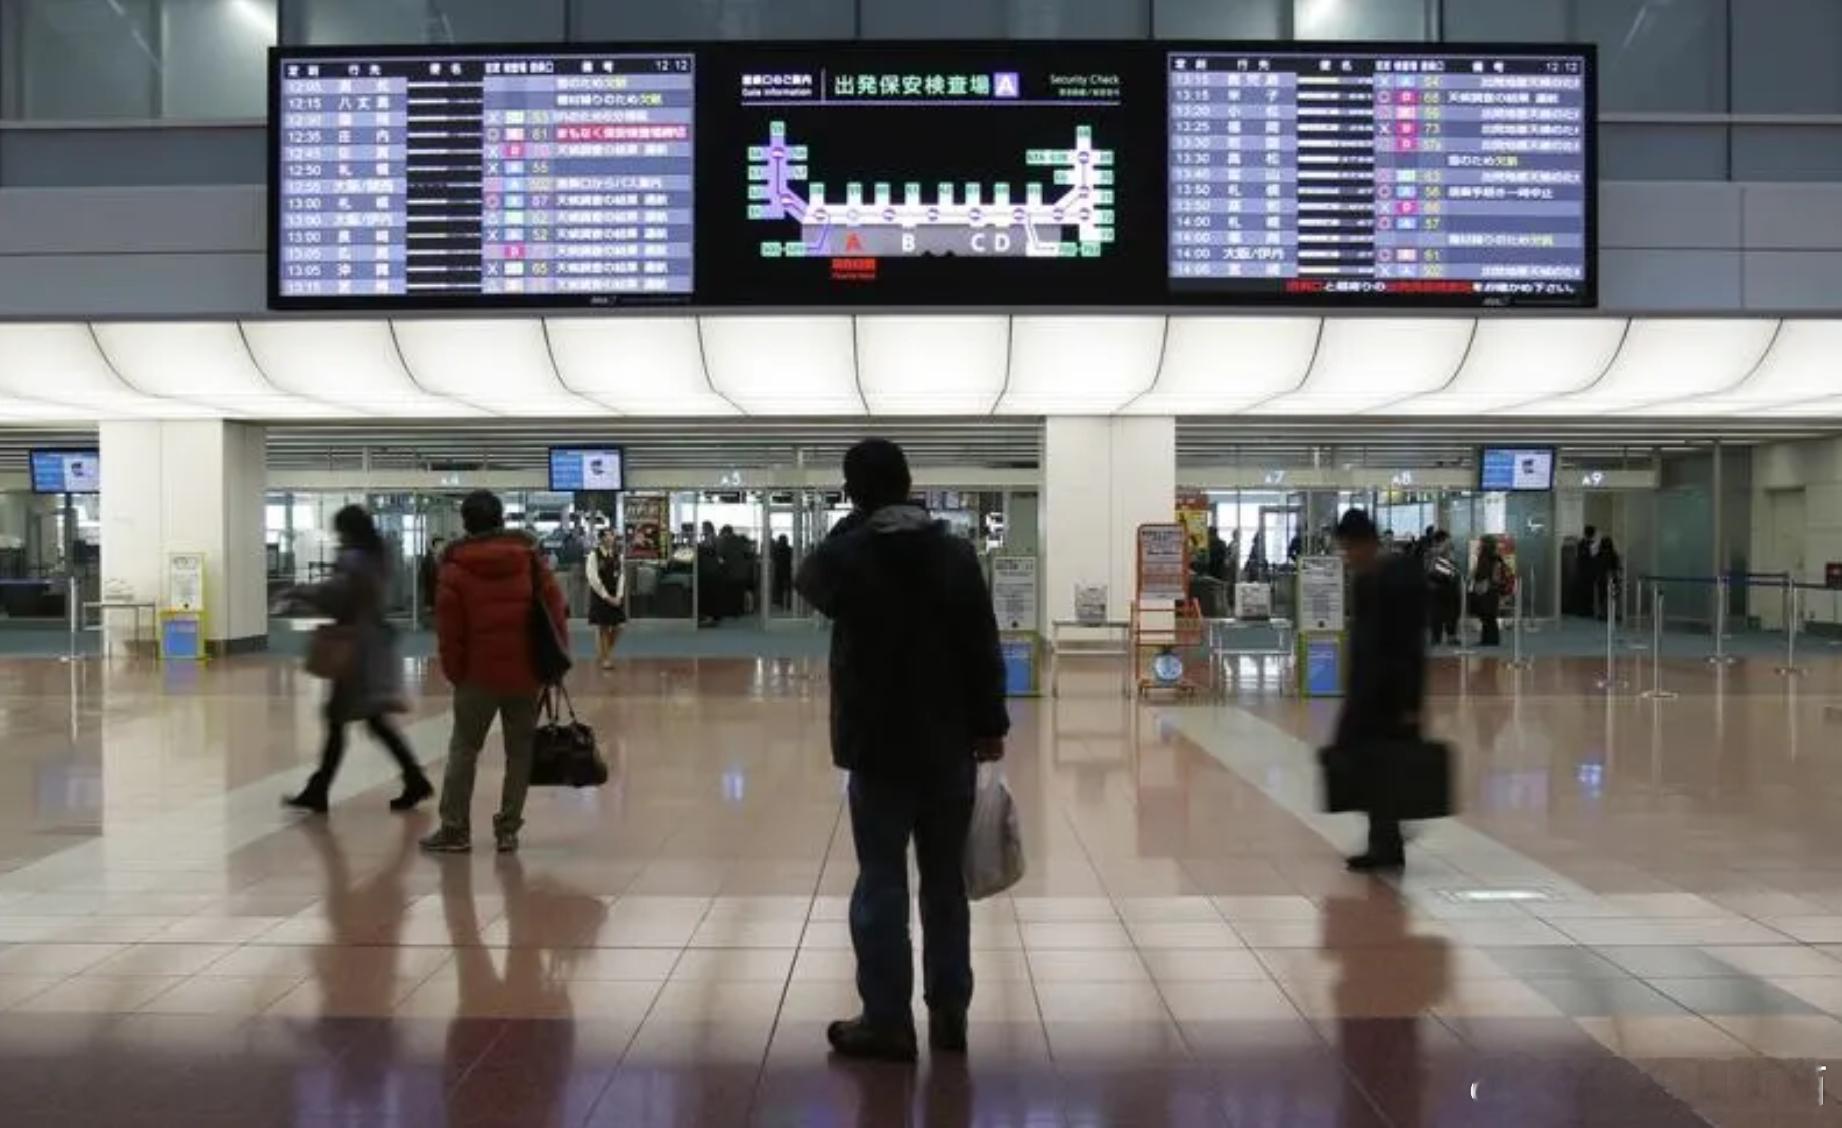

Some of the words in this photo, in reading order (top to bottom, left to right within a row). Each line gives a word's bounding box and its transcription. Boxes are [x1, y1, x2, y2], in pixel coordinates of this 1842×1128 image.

[834, 74, 990, 96] 出発保安検査場
[1051, 74, 1087, 86] Security
[1091, 74, 1120, 85] Check
[846, 232, 862, 252] A
[902, 233, 916, 252] B
[971, 233, 985, 252] C
[995, 233, 1010, 252] D
